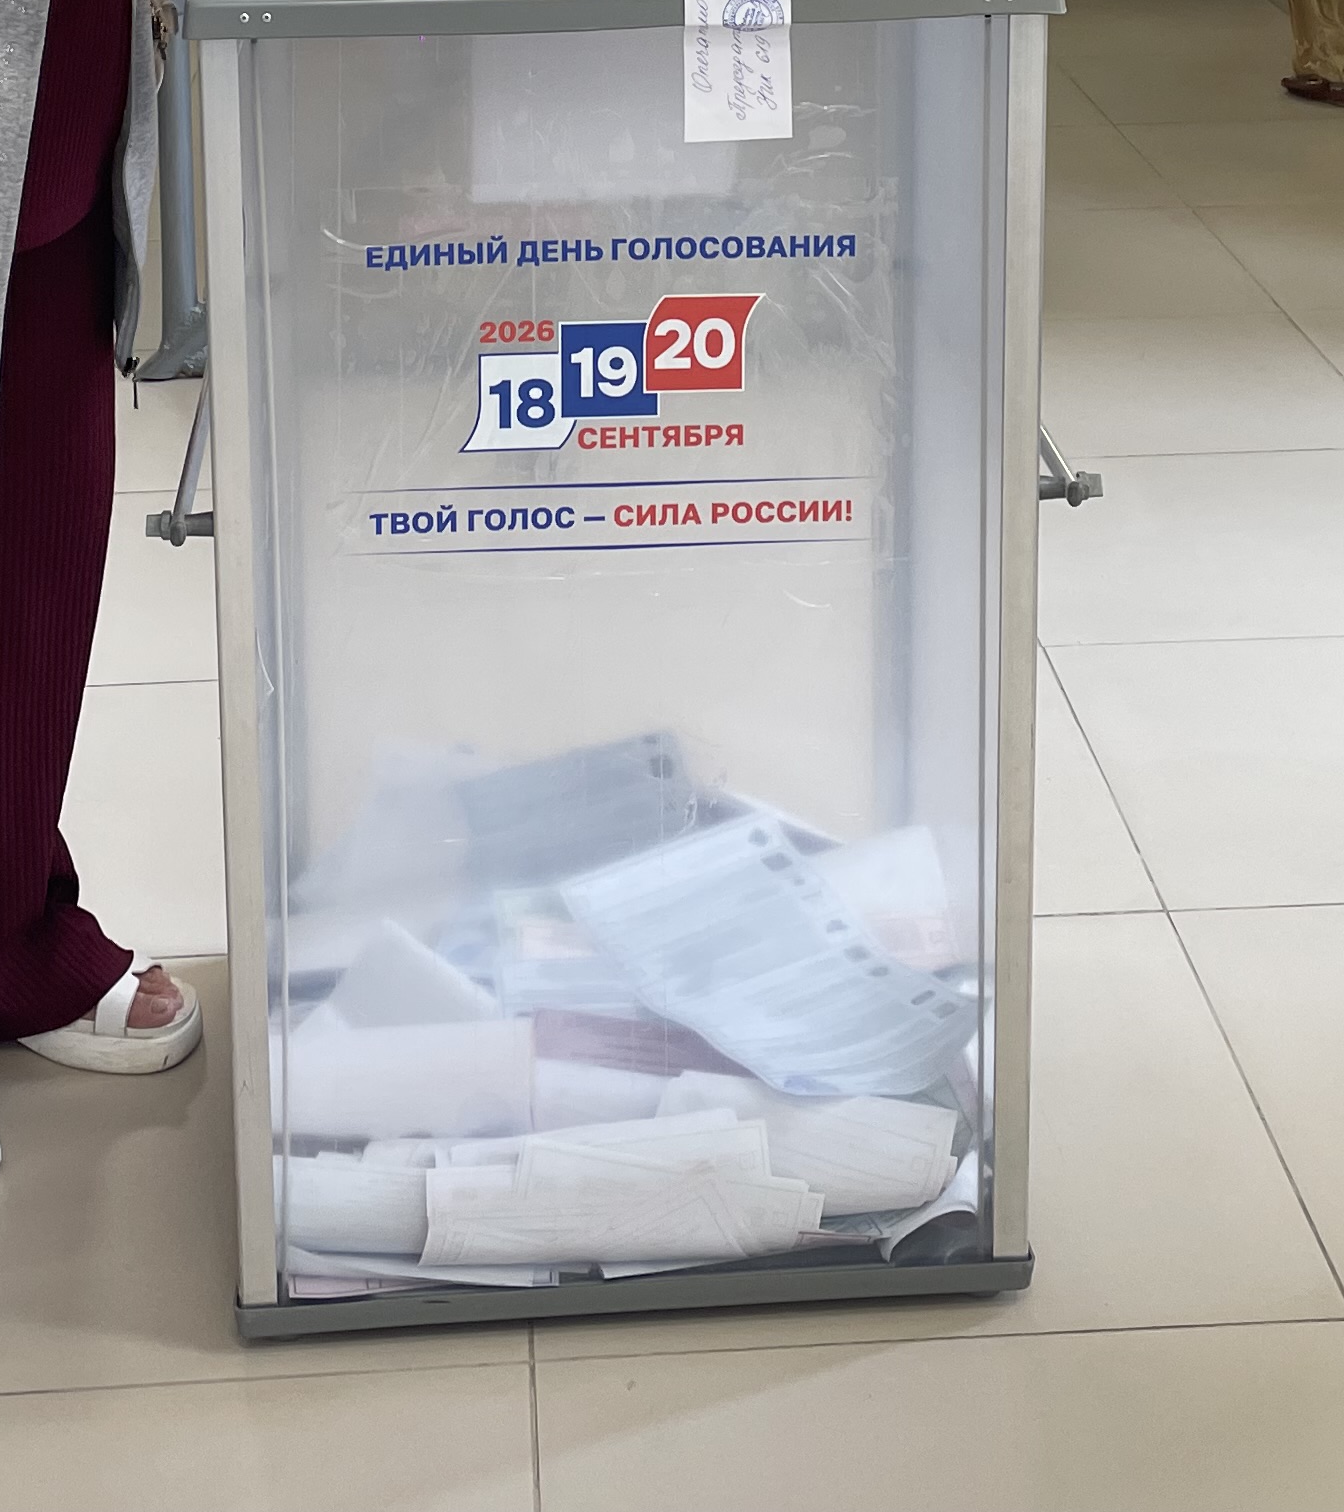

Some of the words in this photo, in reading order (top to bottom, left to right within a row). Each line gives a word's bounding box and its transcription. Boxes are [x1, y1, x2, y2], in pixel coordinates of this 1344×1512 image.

[365, 236, 508, 270] ЕДИНЫЙ
[516, 239, 605, 267] ДЕНЬ
[610, 234, 857, 262] ГОЛОСОВАНИЯ
[479, 320, 556, 344] 2026
[488, 378, 556, 430] 18
[569, 346, 638, 399] 19
[654, 317, 737, 371] 20
[577, 423, 744, 450] СЕНТЯБРЯ
[369, 504, 458, 536] ТВОЙ
[467, 506, 575, 533] ГОЛОС
[613, 502, 702, 528] СИЛА
[710, 499, 853, 525] РОССИИ!
